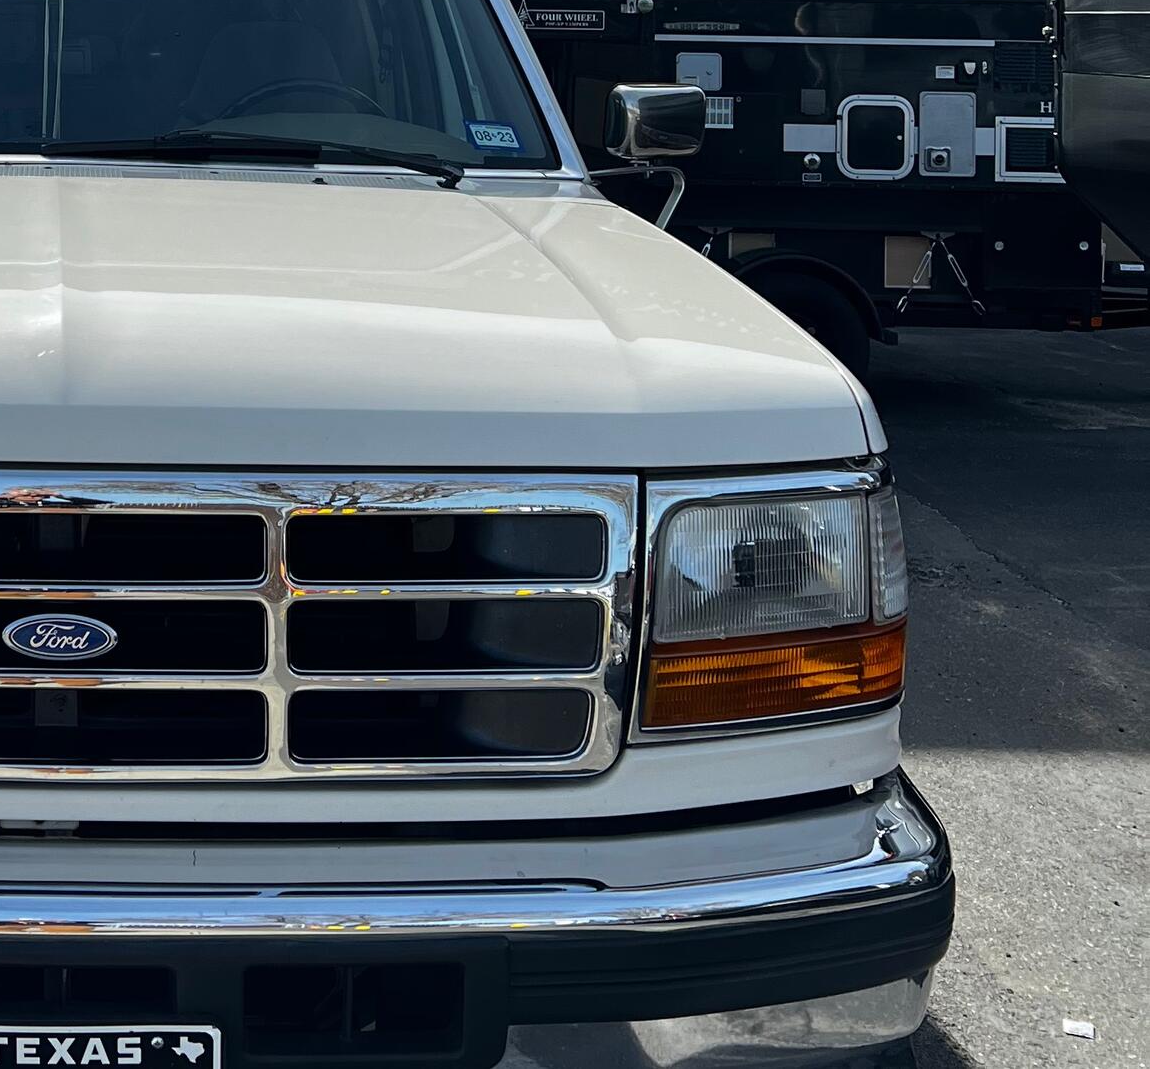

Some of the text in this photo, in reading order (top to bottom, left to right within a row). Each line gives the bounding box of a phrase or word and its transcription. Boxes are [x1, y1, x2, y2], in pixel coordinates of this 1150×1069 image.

[535, 13, 599, 22] FOUR WHEEL
[474, 130, 514, 143] 08 23
[30, 623, 91, 649] Ford
